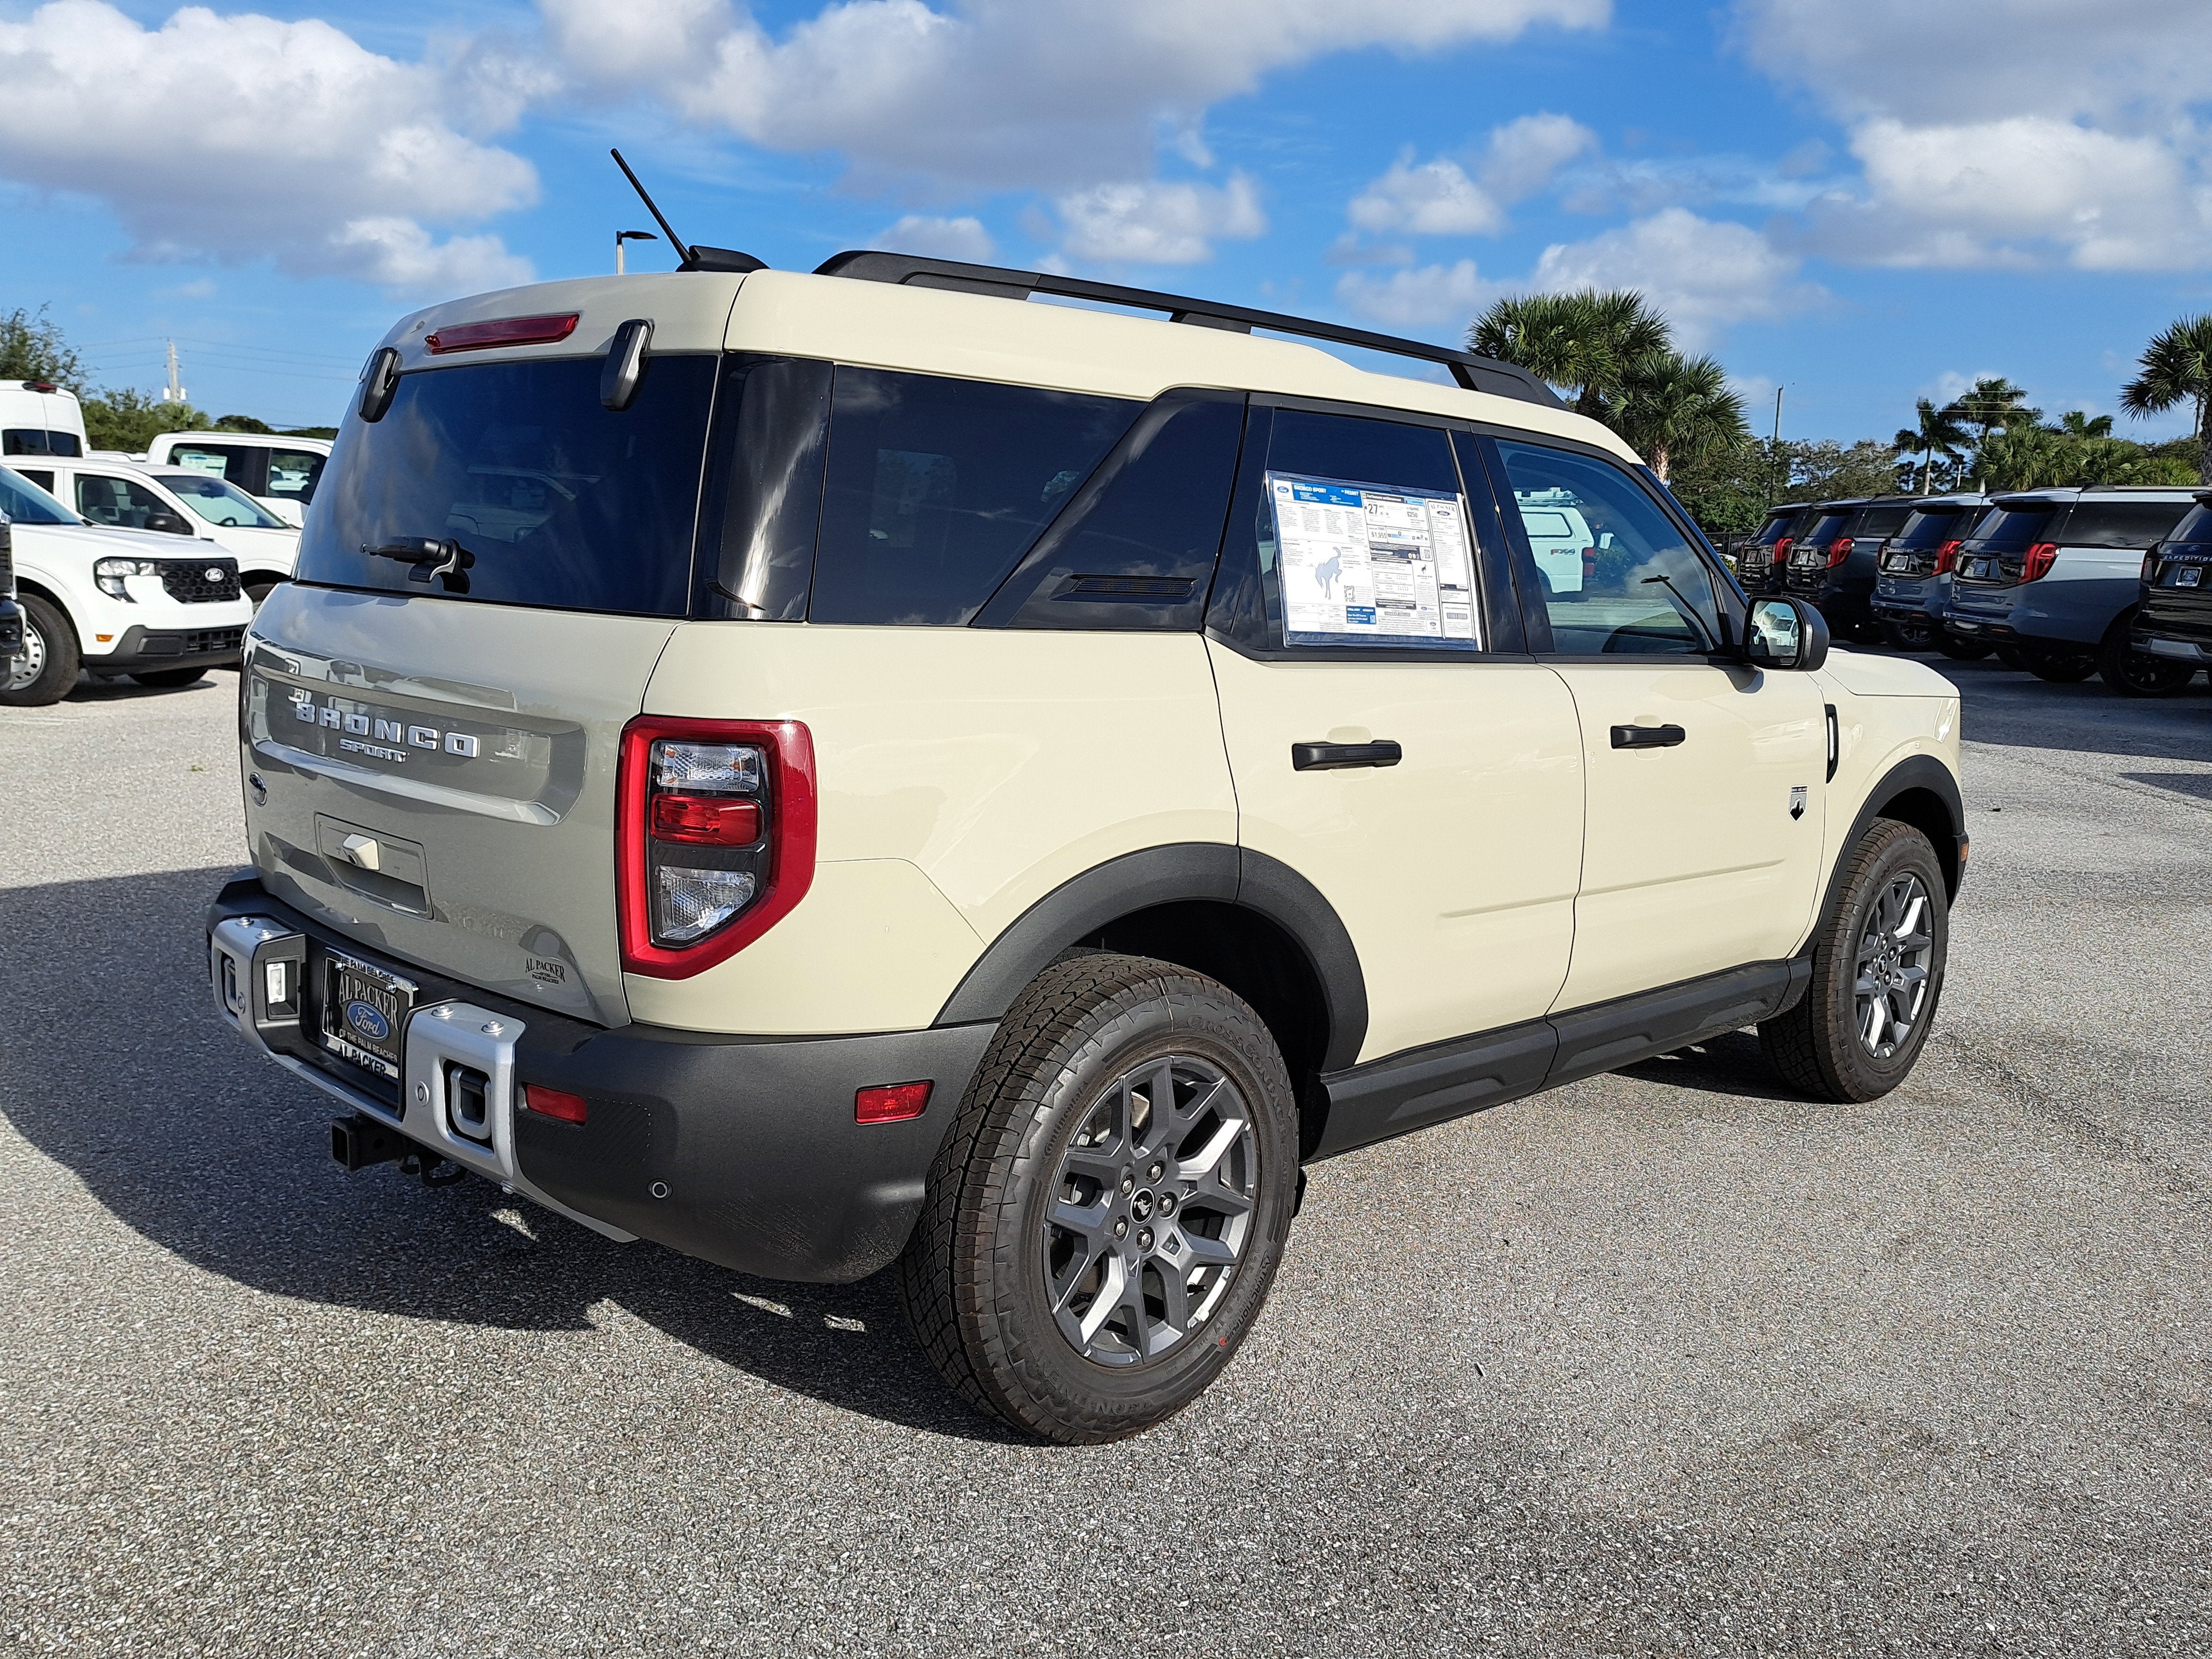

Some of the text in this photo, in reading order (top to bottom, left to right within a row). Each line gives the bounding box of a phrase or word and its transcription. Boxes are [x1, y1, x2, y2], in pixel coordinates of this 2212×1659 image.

[1368, 504, 1378, 515] 27
[296, 702, 481, 759] BRONCO
[339, 738, 409, 763] SPORT
[525, 958, 565, 983] AL PACKER
[338, 972, 399, 1032] AL PACKER
[355, 1006, 381, 1035] Ford
[339, 1028, 398, 1063] OF THE PALM BEACHES
[352, 1048, 386, 1076] PACKER
[1044, 1086, 1084, 1157] Continental
